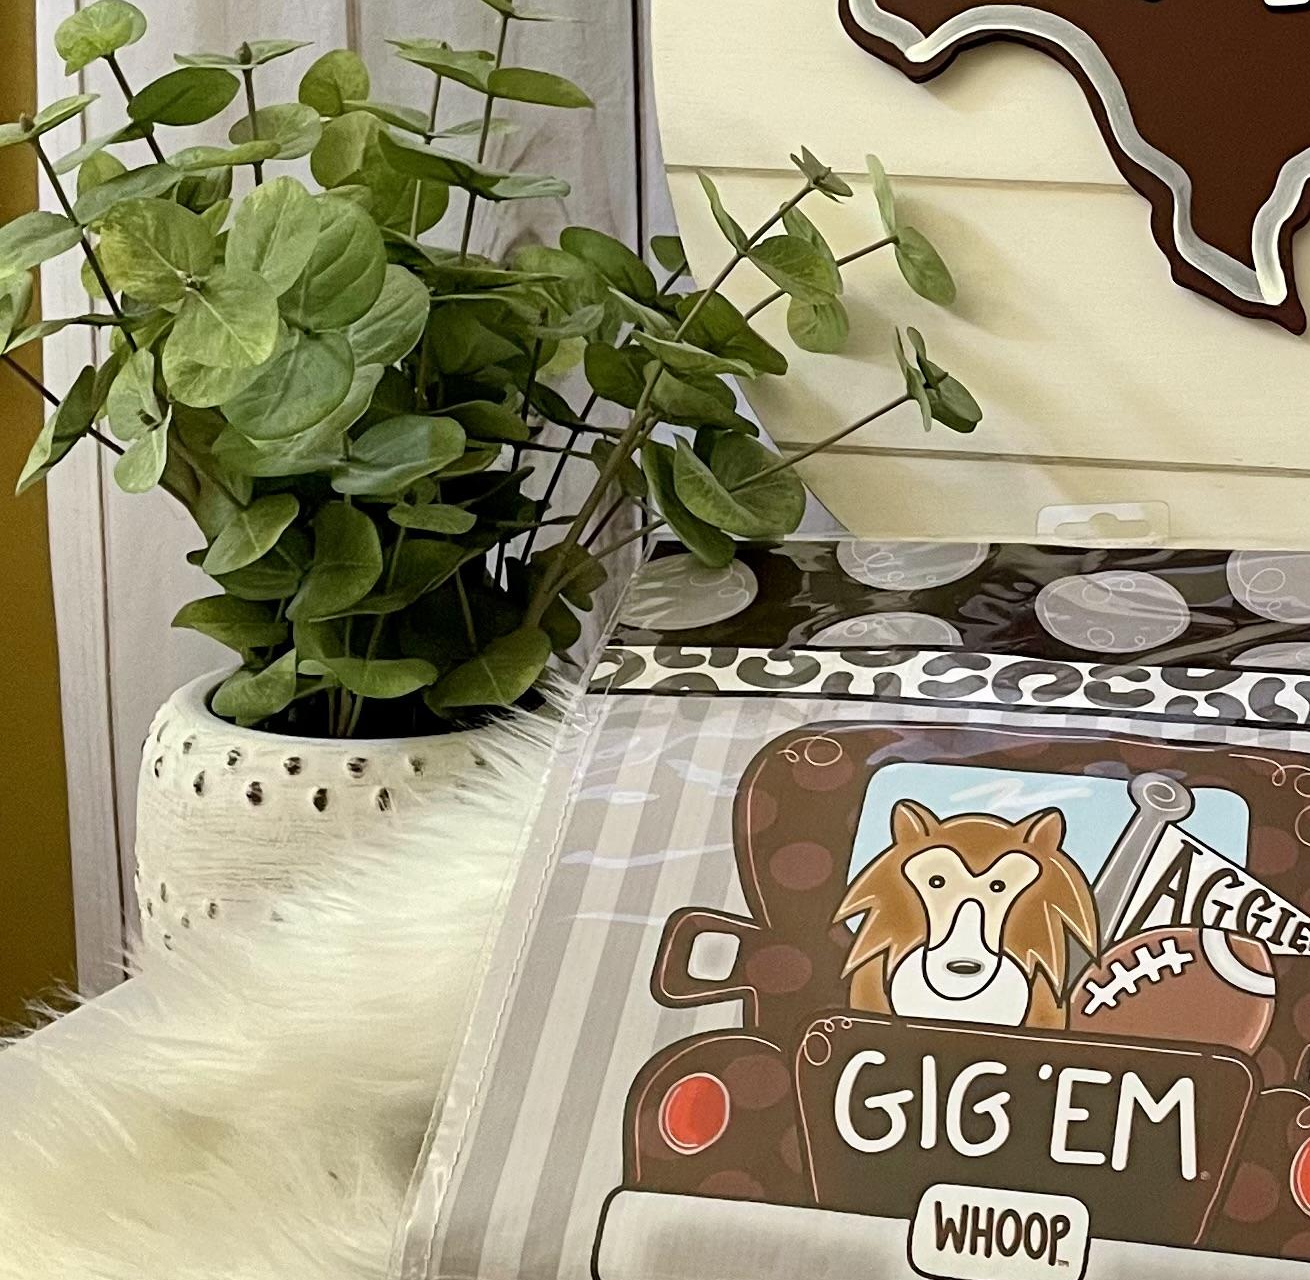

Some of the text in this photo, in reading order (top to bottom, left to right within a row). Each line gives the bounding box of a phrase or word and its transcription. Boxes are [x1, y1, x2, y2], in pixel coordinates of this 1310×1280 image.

[834, 1050, 1198, 1181] GIG 'EM
[934, 1200, 1071, 1267] WHOOP
